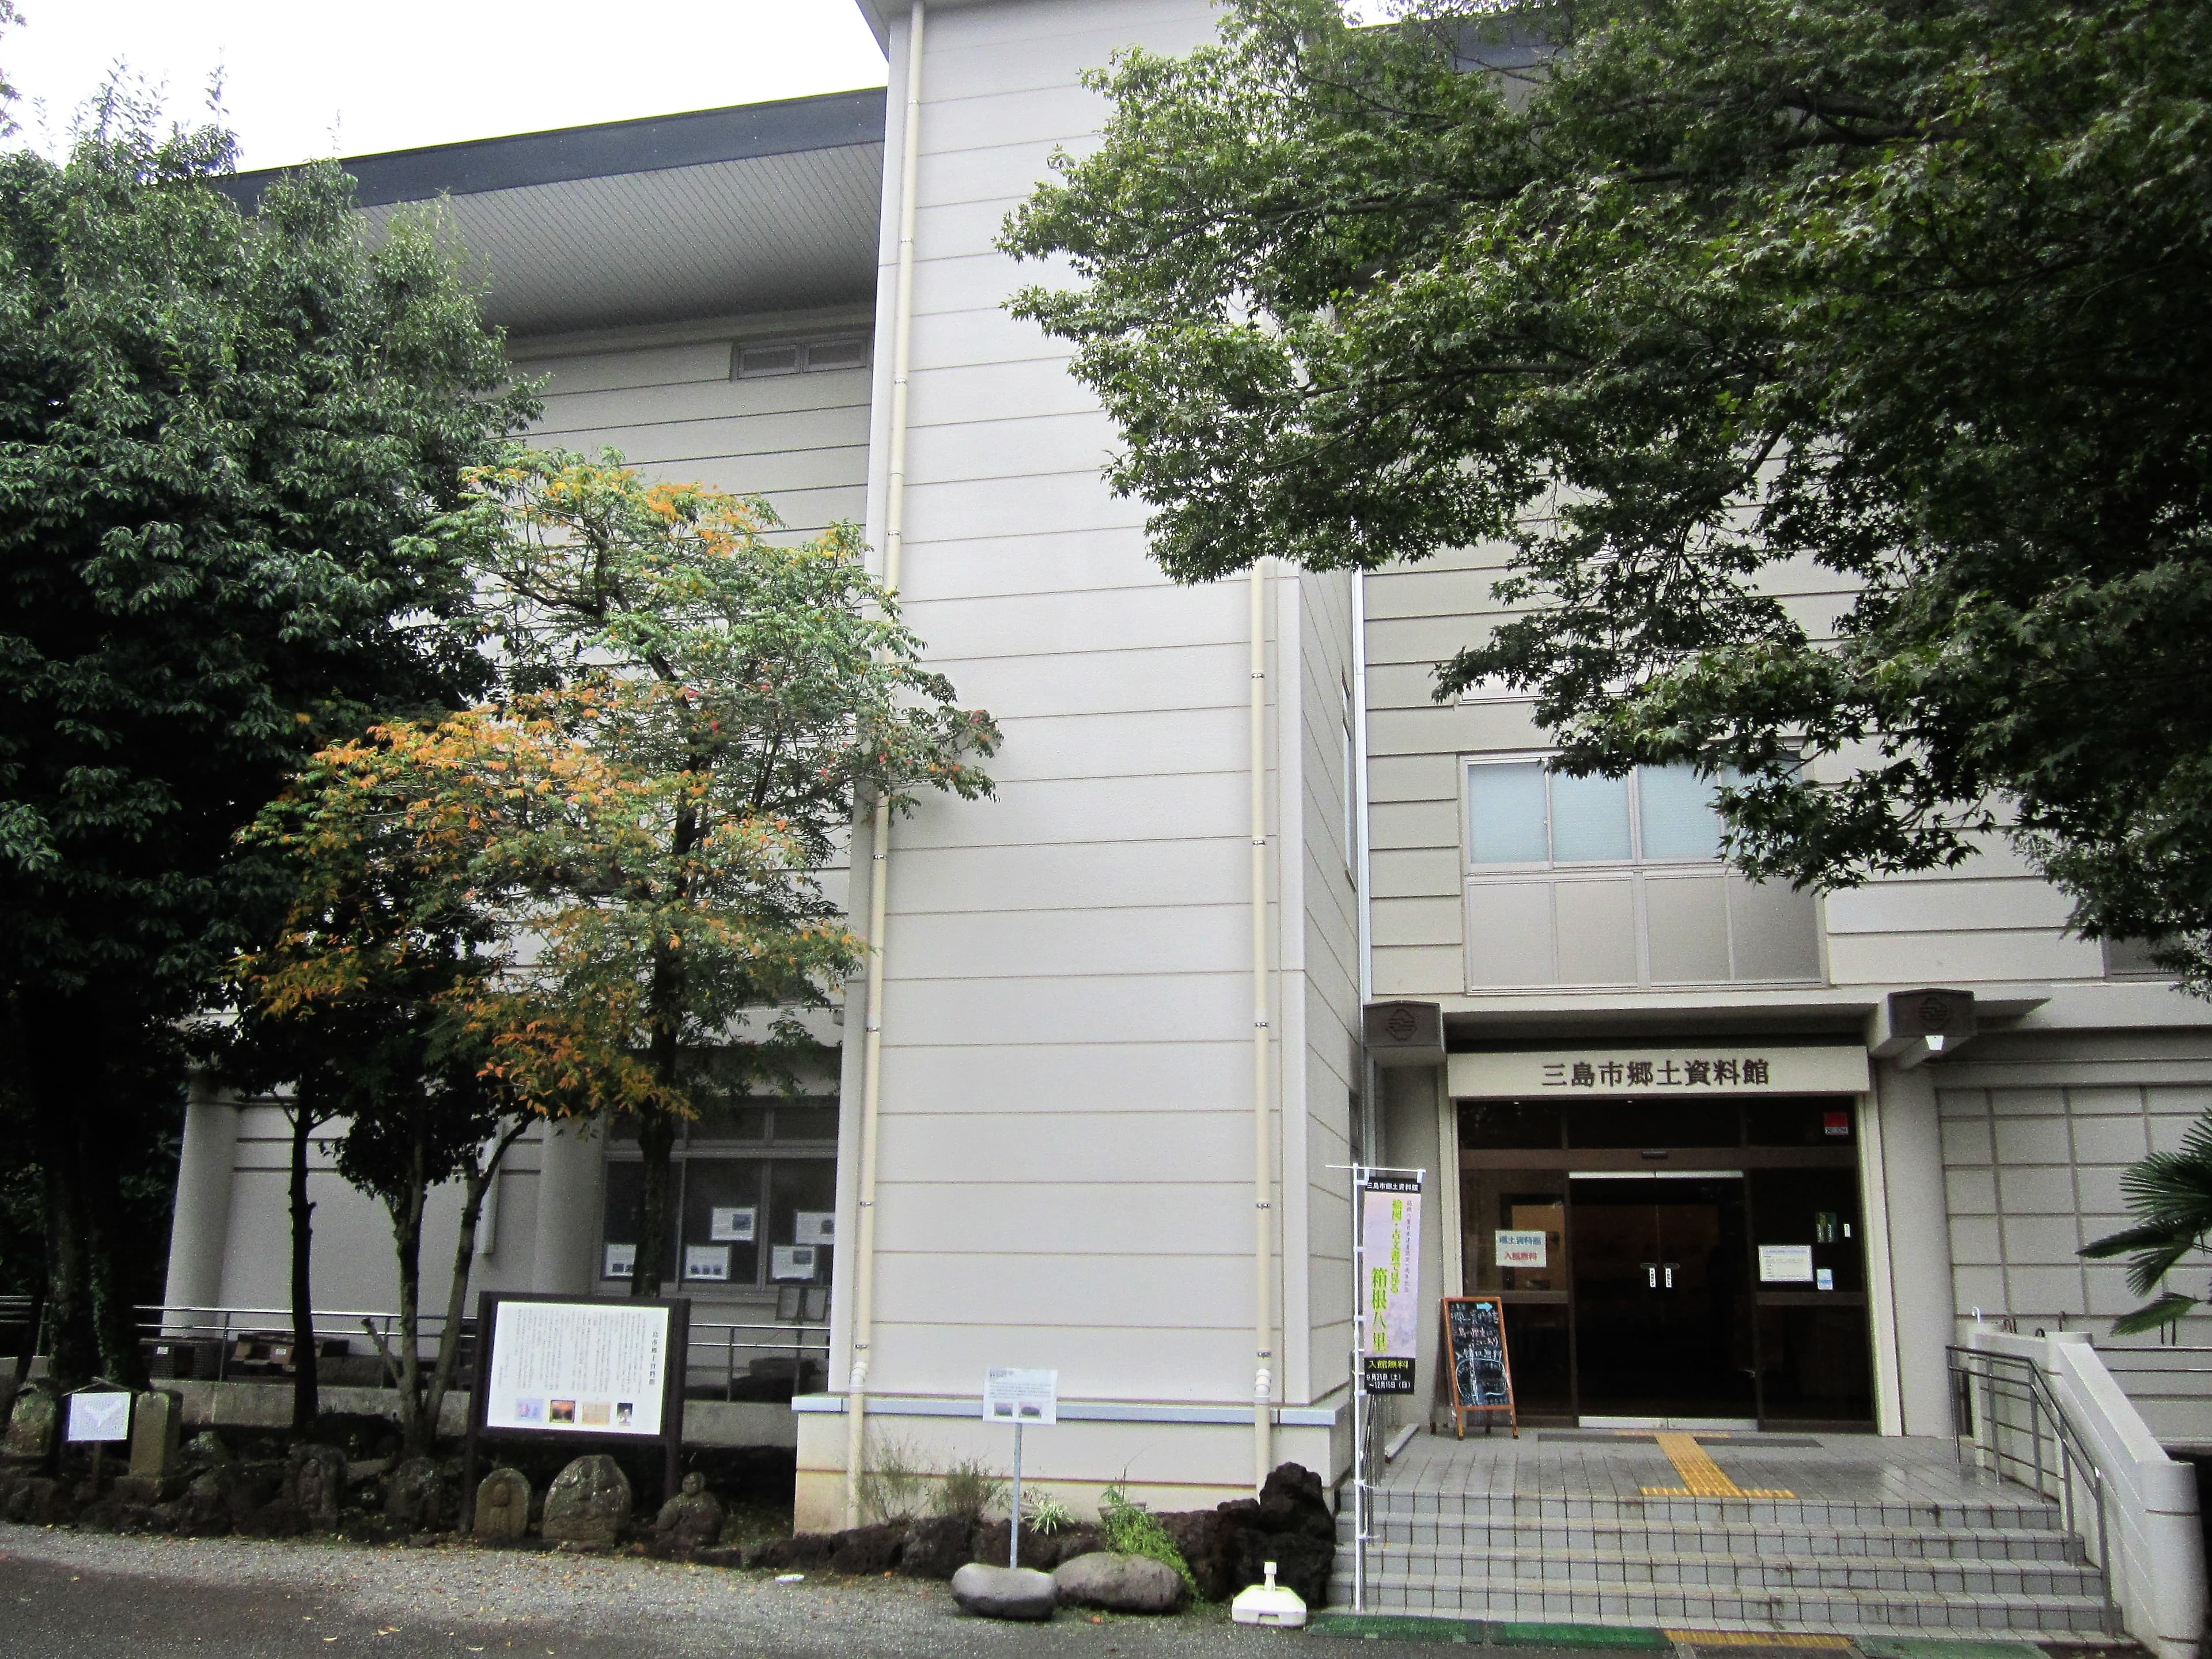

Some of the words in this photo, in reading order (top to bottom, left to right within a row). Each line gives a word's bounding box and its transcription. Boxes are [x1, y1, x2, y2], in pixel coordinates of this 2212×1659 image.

[1541, 1058, 1770, 1088] 三島市郷土資料館
[1367, 1182, 1418, 1191] 三島市郷土資料館
[1372, 1267, 1388, 1353] 箱根八里
[1368, 1360, 1408, 1369] 入館無料
